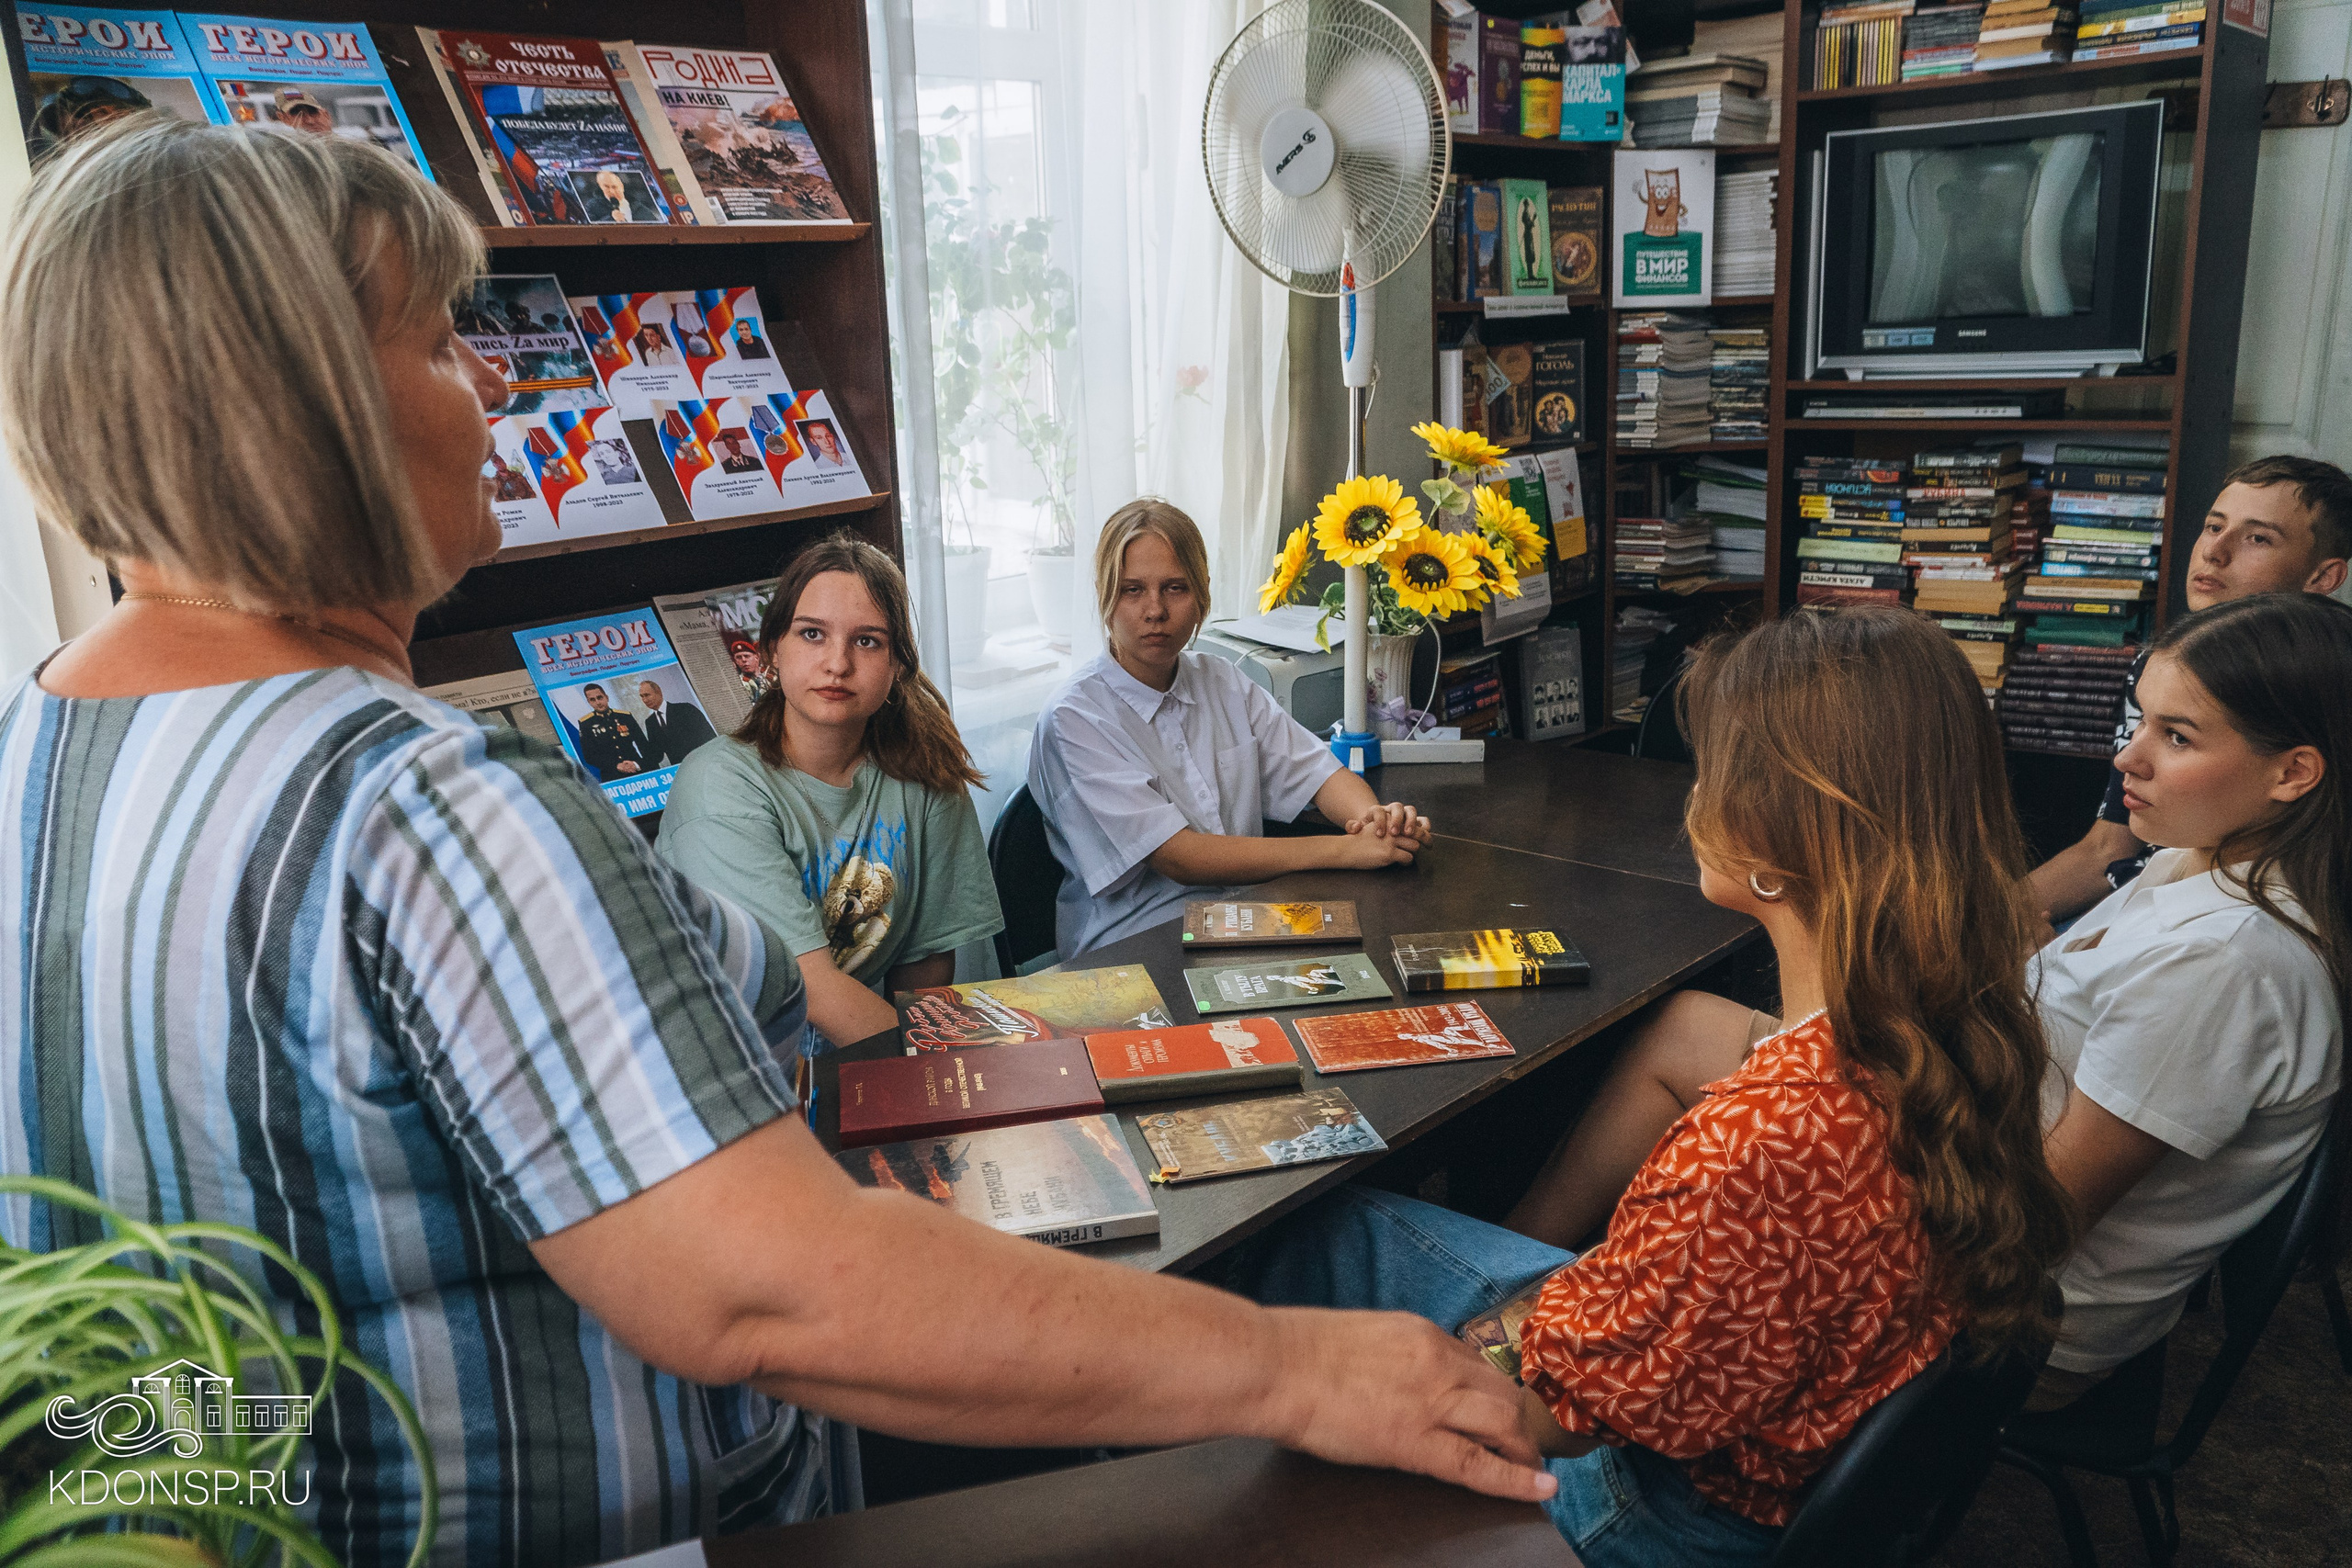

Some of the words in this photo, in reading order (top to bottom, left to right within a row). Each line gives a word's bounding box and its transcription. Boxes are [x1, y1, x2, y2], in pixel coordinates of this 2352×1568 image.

[17, 12, 173, 51] ЕРОИ
[198, 23, 367, 61] ГЕРОИ
[509, 41, 576, 61] ЧЕСТЬ
[495, 59, 607, 80] ОТЕЧЕСТВА
[662, 91, 685, 105] НА
[687, 93, 730, 107] КИЕВ!
[1636, 258, 1646, 275] В
[1649, 257, 1689, 274] МИР
[470, 338, 509, 351] лись
[537, 337, 570, 350] мир
[531, 620, 656, 665] ГЕРОИ
[541, 664, 564, 674] ВСЕХ
[567, 650, 634, 669] ИСТОРИЧЕСКИХ
[637, 645, 659, 654] ЭПОХ
[605, 777, 659, 798] АГОДАРИМ
[660, 773, 673, 785] ЗА
[628, 795, 658, 813] ИМЯ
[1250, 975, 1269, 994] ВРАГА
[979, 1160, 1007, 1211] ГРЕМЯЩЕМ
[1020, 1189, 1041, 1216] НЕБЕ
[1093, 1225, 1102, 1238] В
